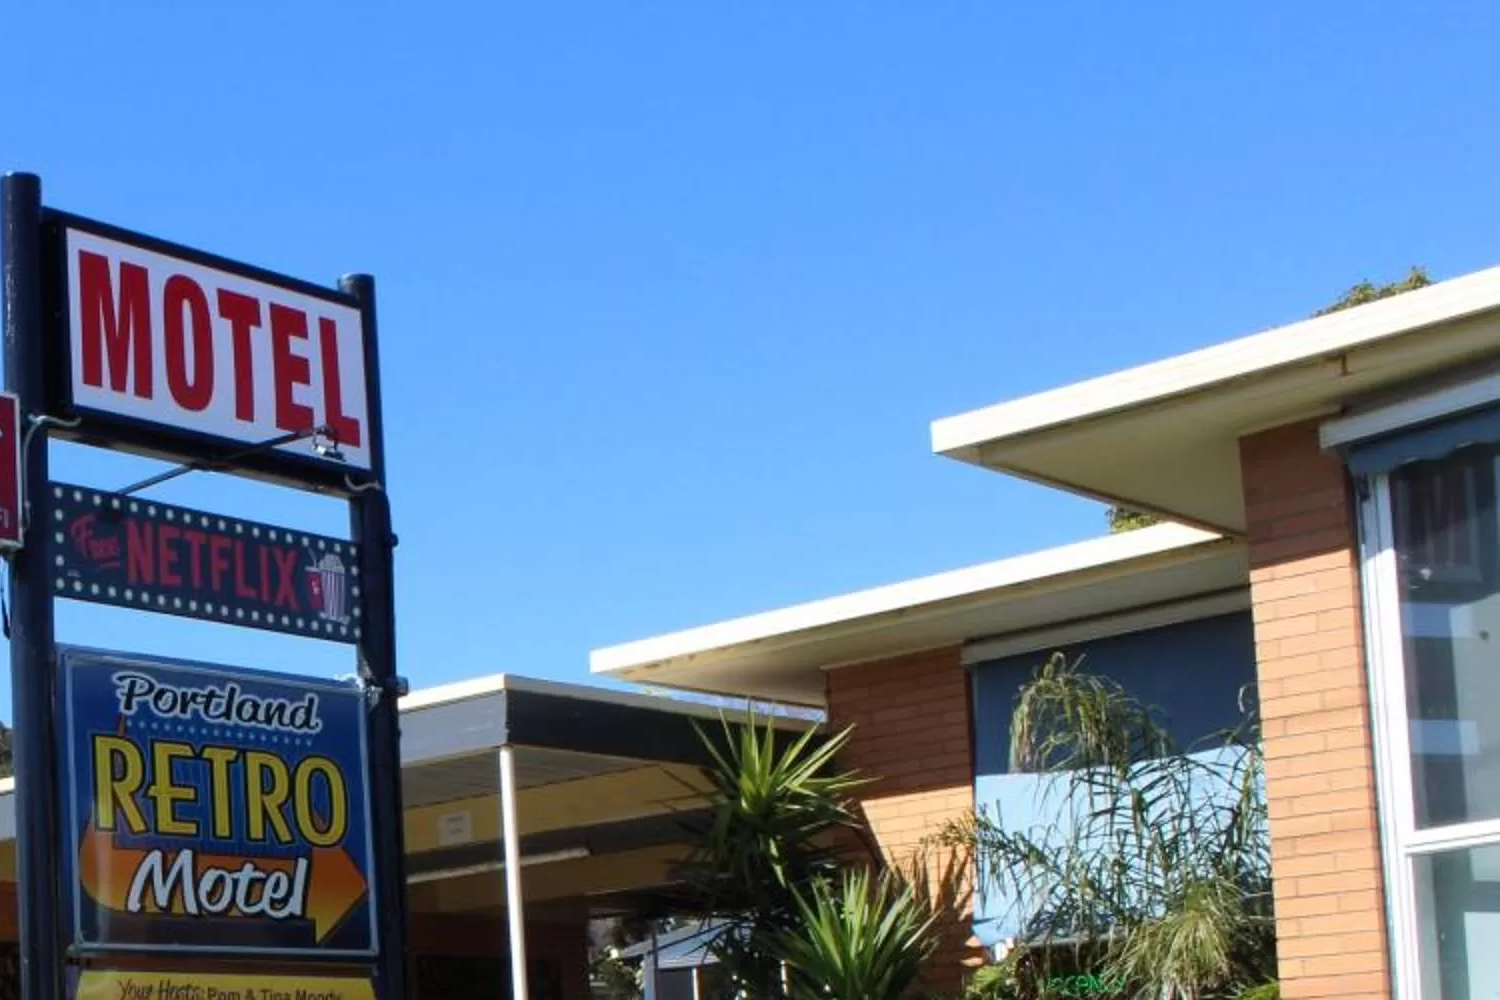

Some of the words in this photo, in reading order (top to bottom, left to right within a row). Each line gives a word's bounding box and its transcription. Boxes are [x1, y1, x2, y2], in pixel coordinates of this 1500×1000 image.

[77, 248, 361, 449] MOTEL
[125, 516, 301, 613] NETFLIX
[112, 671, 322, 732] Portland
[91, 732, 349, 847] RETRO
[126, 848, 309, 920] Motel
